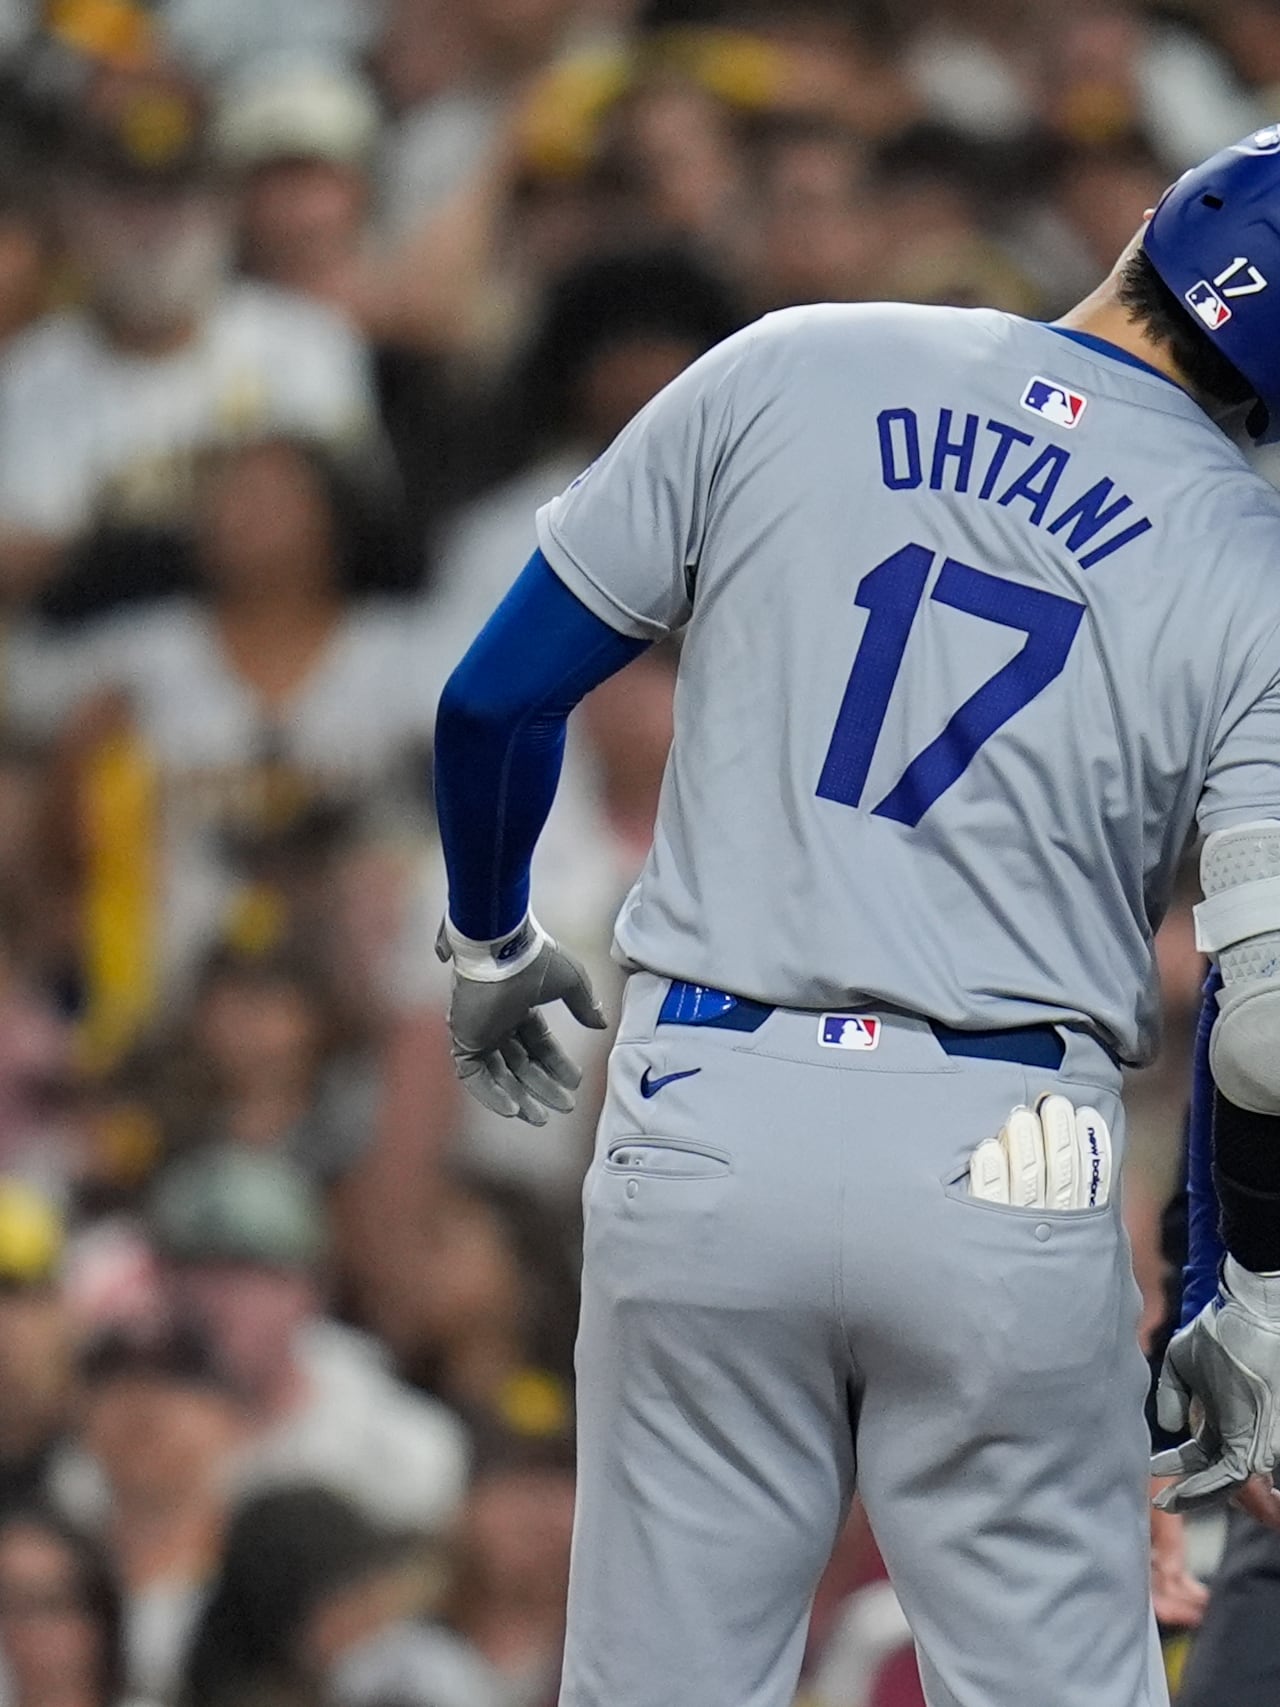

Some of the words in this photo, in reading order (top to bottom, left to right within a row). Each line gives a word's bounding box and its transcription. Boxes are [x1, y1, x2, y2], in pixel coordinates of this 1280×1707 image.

[1212, 256, 1267, 298] 17
[876, 407, 1153, 570] OHTANI
[815, 541, 1087, 828] 17
[1087, 1127, 1099, 1156] new
[1088, 1159, 1101, 1208] balanc
